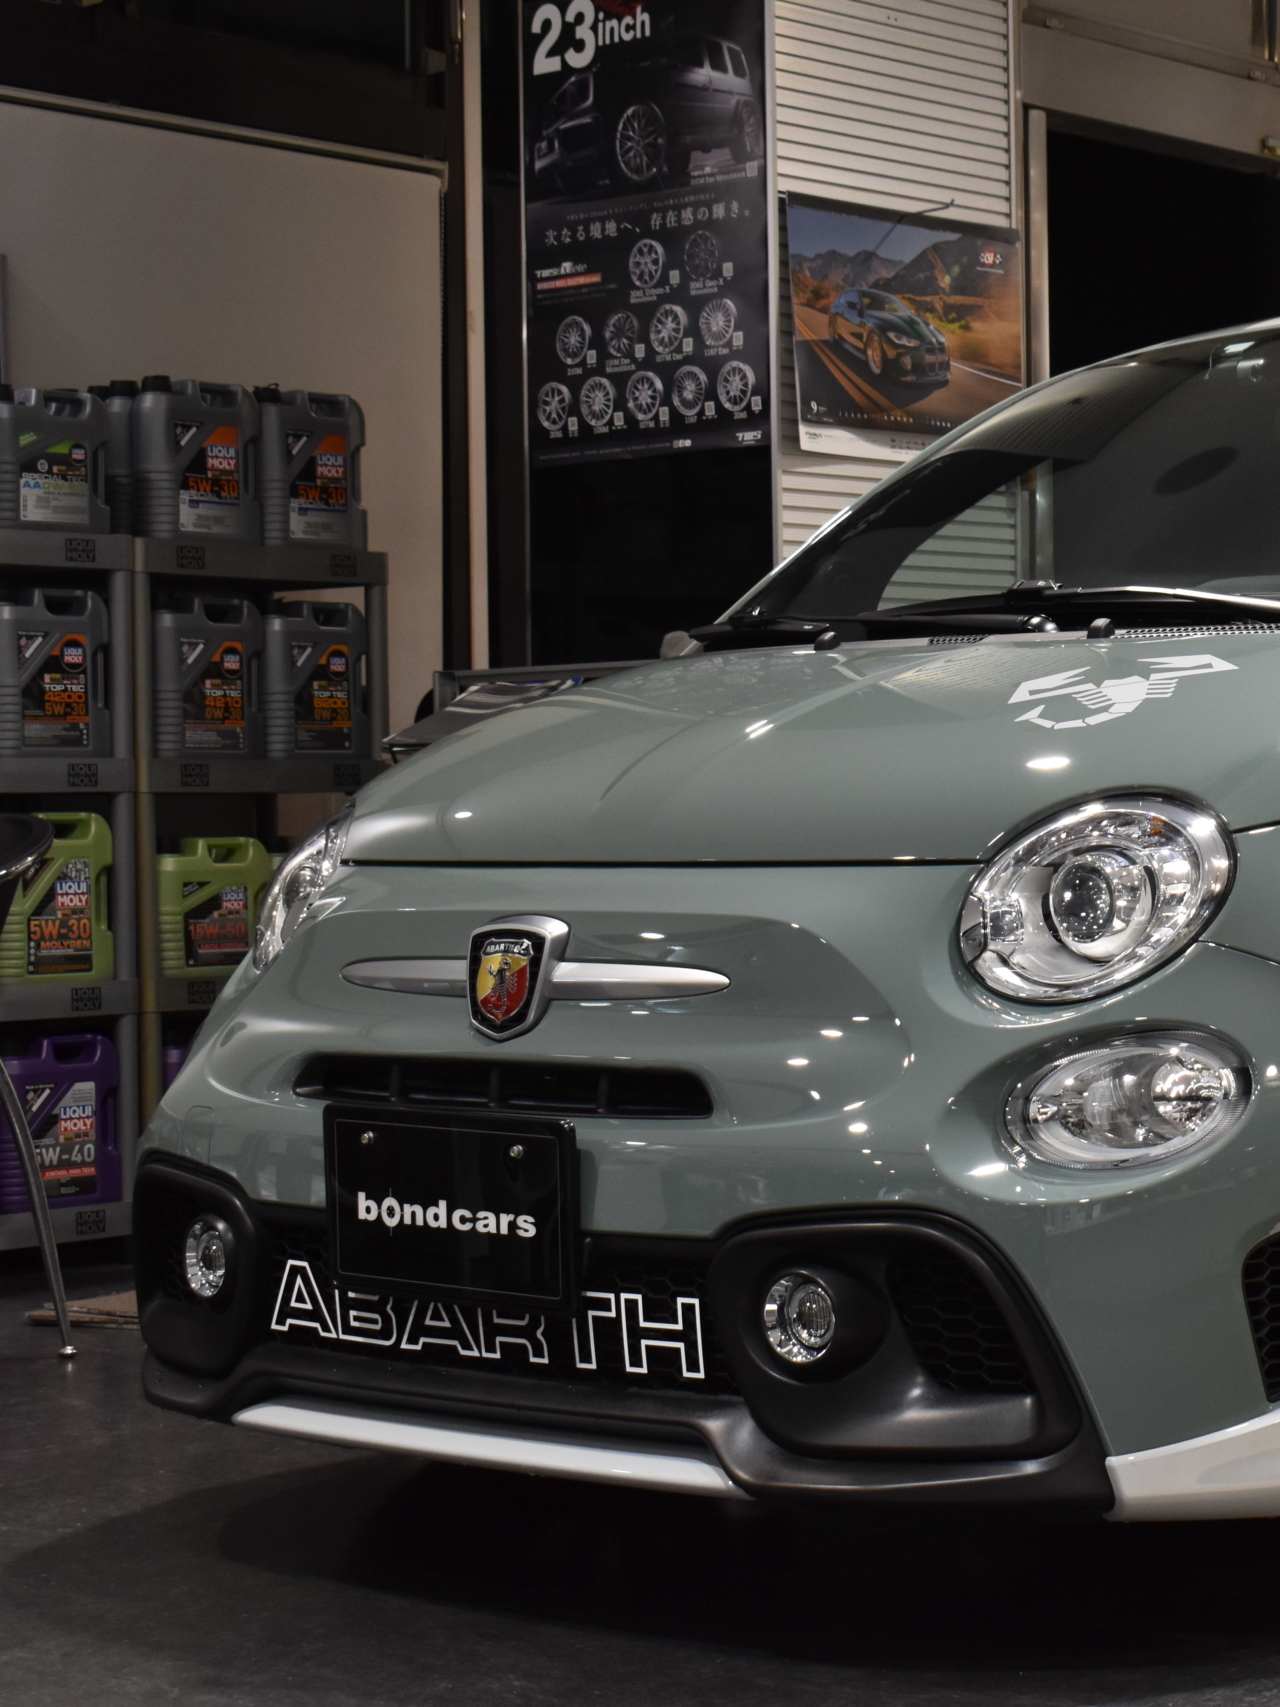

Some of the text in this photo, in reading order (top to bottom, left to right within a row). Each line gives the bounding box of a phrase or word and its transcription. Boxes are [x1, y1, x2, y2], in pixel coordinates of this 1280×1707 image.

[207, 445, 236, 457] LIQUI
[207, 458, 237, 470] MOLY
[317, 454, 343, 466] LIQUI
[317, 466, 344, 477] MOLY
[188, 477, 239, 496] 5W-30
[298, 485, 347, 504] 5W-30
[66, 539, 95, 549] LIQUI
[66, 551, 95, 561] MOLY
[63, 647, 83, 656] LIQUI
[63, 655, 83, 663] MOLY
[66, 684, 85, 692] TEC
[205, 689, 224, 697] TOP
[44, 692, 85, 703] 4200
[204, 697, 242, 707] 4210
[44, 703, 86, 716] 5W-30
[205, 707, 242, 720] 0W-30
[69, 764, 96, 774] LIQUI
[69, 775, 97, 786] MOLY
[57, 881, 87, 893] LIQUI
[57, 894, 89, 907] MOLY
[223, 892, 244, 900] LIQUI
[223, 901, 245, 909] MOLY
[29, 918, 91, 940] 5W-30
[189, 922, 245, 940] 15W-50
[40, 940, 91, 950] MOLYGEN
[72, 988, 100, 999] LIQUI
[72, 1000, 101, 1010] MOLY
[60, 1105, 92, 1118] LIQUI
[60, 1119, 93, 1131] MOLY
[77, 1212, 105, 1222] LIQUI
[77, 1223, 106, 1234] MOLY
